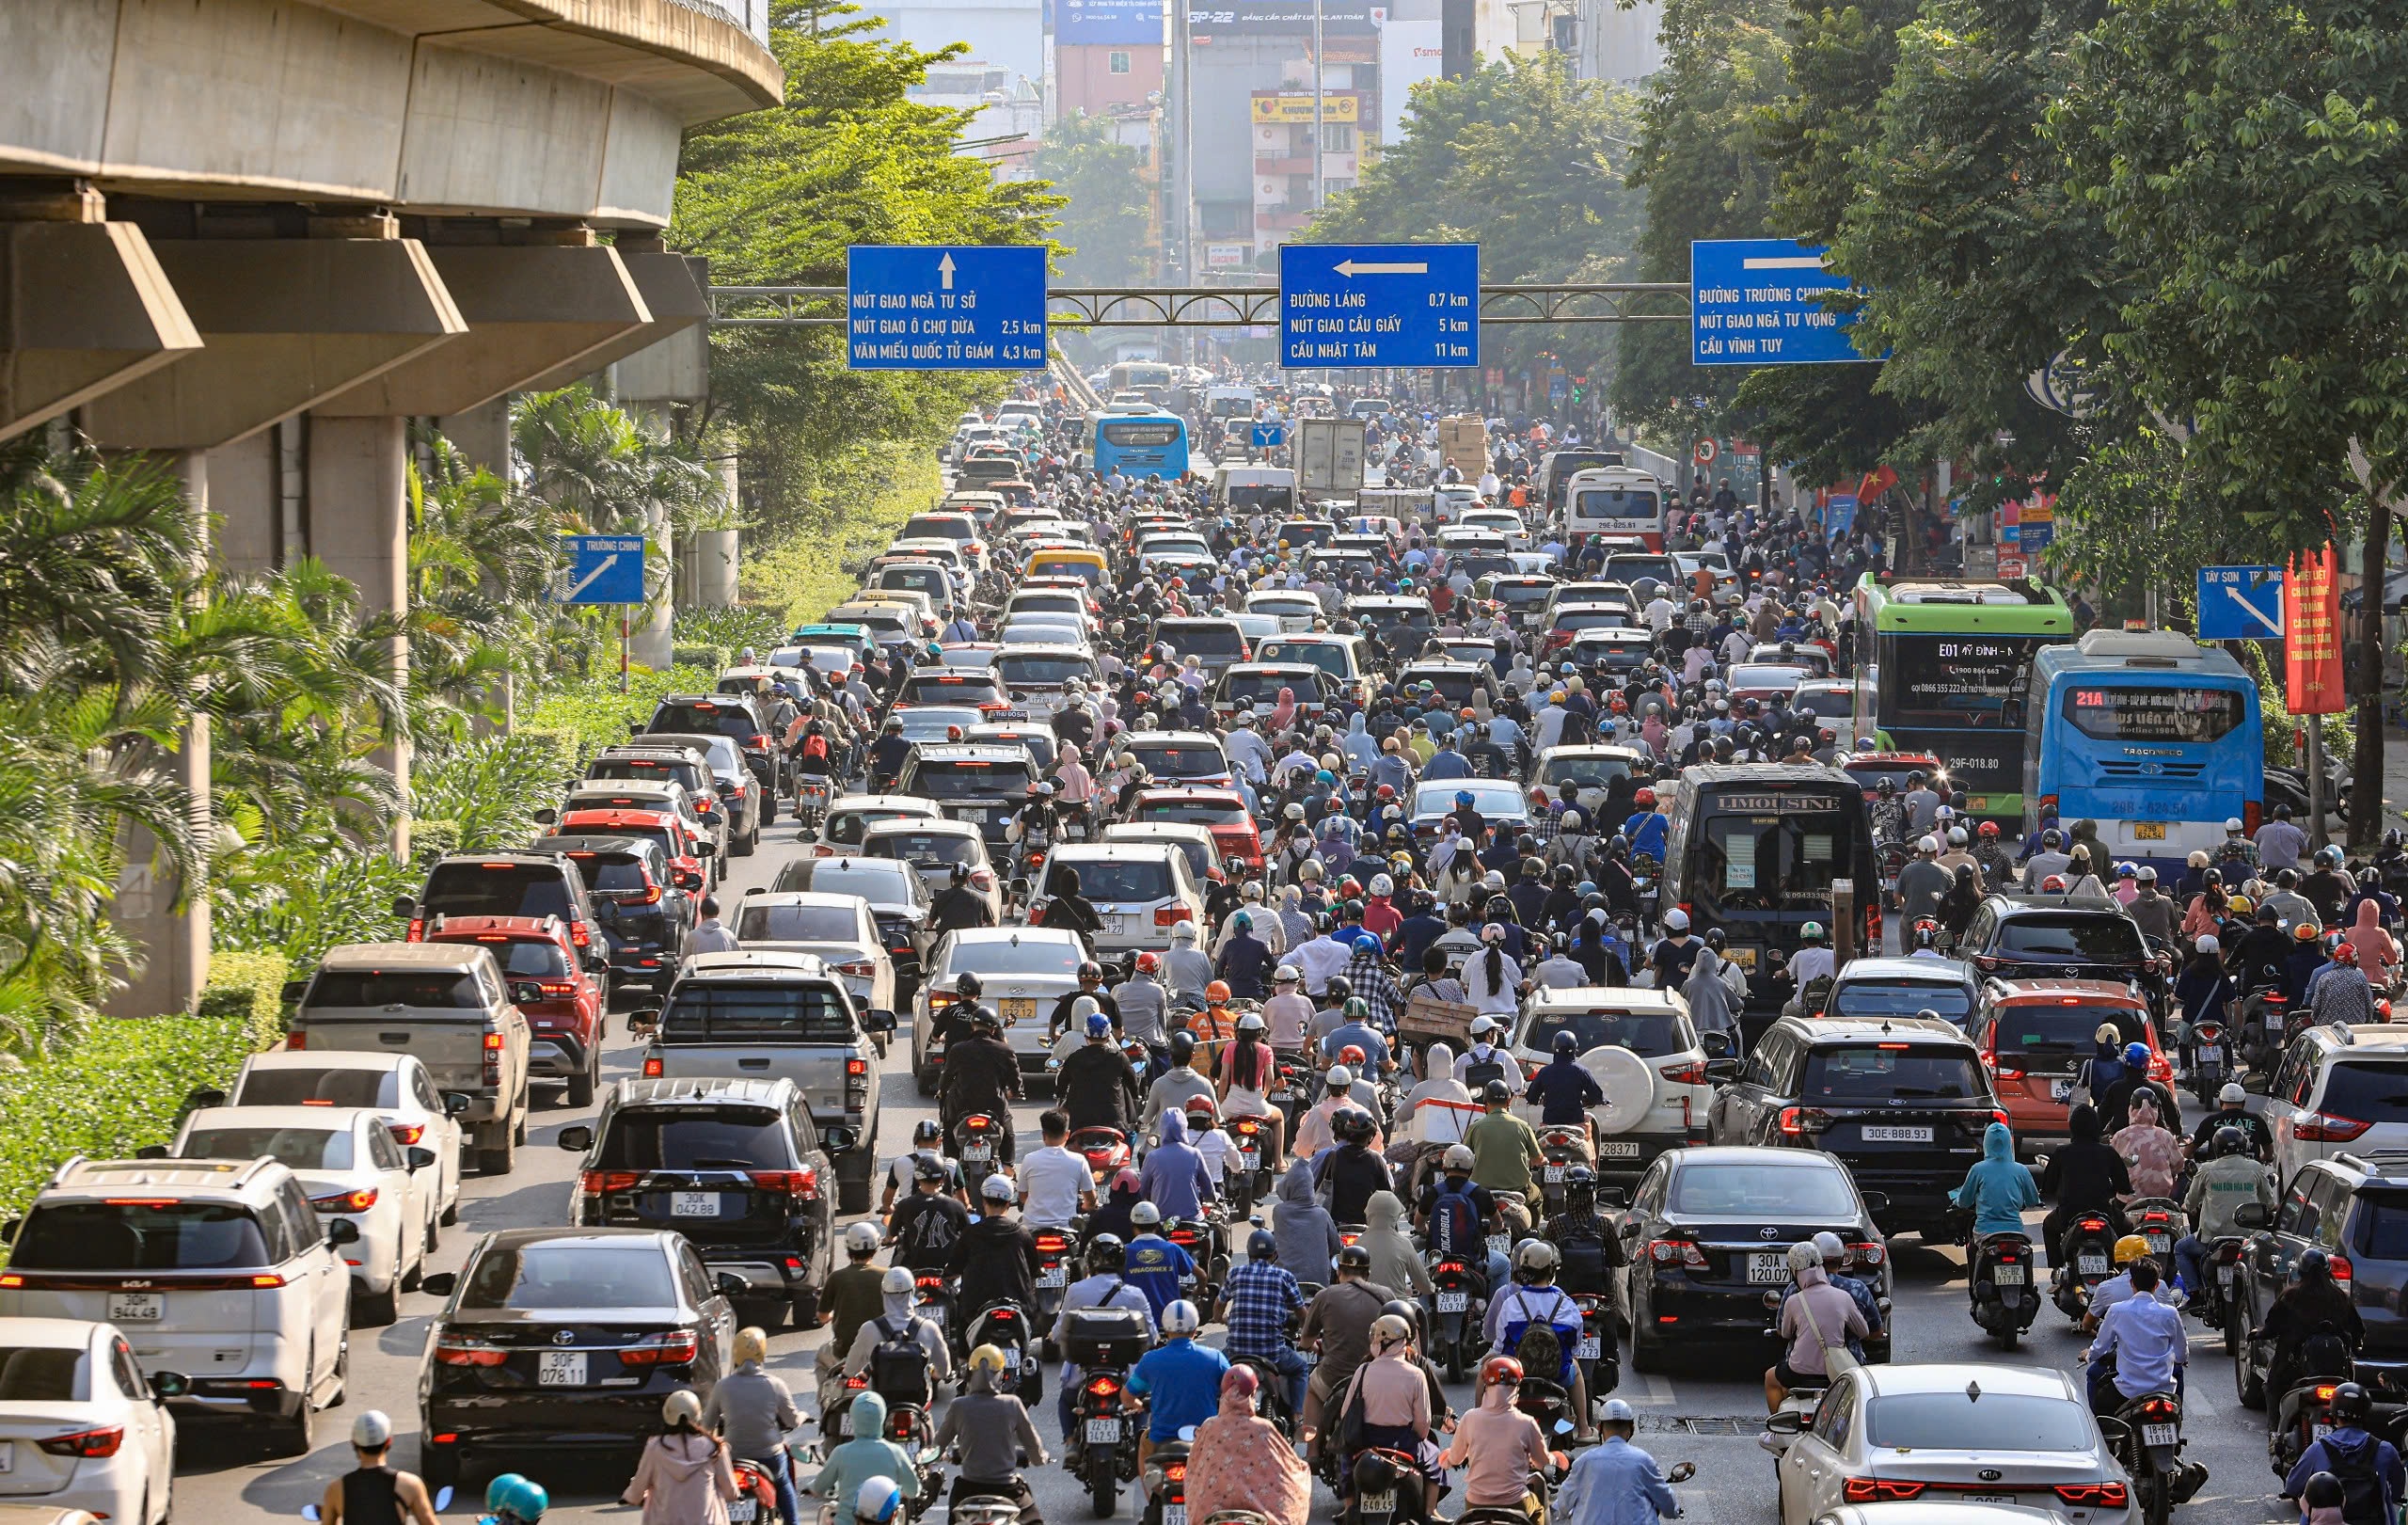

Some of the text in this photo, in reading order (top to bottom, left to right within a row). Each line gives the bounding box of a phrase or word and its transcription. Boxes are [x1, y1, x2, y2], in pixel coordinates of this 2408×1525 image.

[853, 290, 976, 309] NÚT GIAO NGÃ TƯ SỞ
[1290, 290, 1330, 308] ĐƯỜNG
[1336, 290, 1366, 308] LÁNG
[1450, 294, 1468, 307] km
[1699, 284, 1791, 304] ĐƯỜNG TRƯỜNG
[1291, 314, 1468, 333] NÚT GIAO CẦU GIẤY 5 km
[1700, 310, 1836, 329] NÚT GIAO NGÃ TƯ VỌNG
[854, 316, 876, 334] NÚT
[879, 320, 906, 334] GIAO
[911, 318, 919, 334] Ô
[923, 320, 946, 337] CHỢ
[952, 316, 974, 334] DỪA
[1023, 321, 1041, 334] km
[854, 342, 877, 358] VĂN
[880, 341, 908, 358] MIẾU
[911, 341, 943, 359] QUỐC
[946, 342, 962, 358] TỬ
[965, 342, 993, 358] GIÁM
[1023, 345, 1041, 358] km
[1291, 340, 1468, 359] CẦU NHẬT TÂN 11 km
[1700, 336, 1782, 354] CẦU VĨNH TUY
[1414, 503, 1431, 513] 24H
[586, 538, 641, 551] TRƯỜNG CHINH
[2205, 570, 2219, 582] TÂY
[2291, 586, 2309, 597] CHÀO
[2293, 617, 2311, 628] CÁCH
[1939, 643, 1998, 657] E01 ĐÌNH
[2314, 649, 2332, 659] CÔNG
[1921, 684, 1936, 693] 0866
[1937, 684, 1948, 693] 355
[1949, 685, 1960, 693] 222
[2077, 691, 2103, 706] 21A
[2136, 711, 2162, 724] LIÊN
[2118, 725, 2153, 734] Hotline
[1950, 758, 1999, 770] 29F-018.80
[1718, 798, 1840, 809] LIMOUSINE
[1101, 915, 1117, 925] 29A
[1009, 1000, 1025, 1009] 29G
[2213, 1119, 2256, 1129] SKATE
[1868, 1129, 1927, 1139] 30E-888.93
[1601, 1143, 1637, 1155] -283.71
[685, 1193, 705, 1203] 30K
[676, 1204, 714, 1215] 042.88
[1440, 1208, 1450, 1253] JOGARBOLA
[1758, 1254, 1781, 1268] 30A
[1129, 1265, 1167, 1274] VINACONEX
[2000, 1267, 2020, 1276] 15-B2
[2081, 1264, 2105, 1273] 562.97
[1751, 1268, 1790, 1282] 120.07
[1998, 1276, 2022, 1284] 117.63
[1038, 1278, 1063, 1286] 980.25
[1441, 1294, 1462, 1302] 28-G1
[1439, 1302, 1465, 1311] 249.28
[551, 1353, 575, 1367] 30F
[540, 1368, 583, 1383] 078.11
[1091, 1421, 1114, 1430] 22-F1
[2148, 1424, 2171, 1435] 18-P8
[1089, 1431, 1117, 1441] 342.52
[2149, 1435, 2173, 1444] 1818
[1363, 1501, 1393, 1511] 640.45
